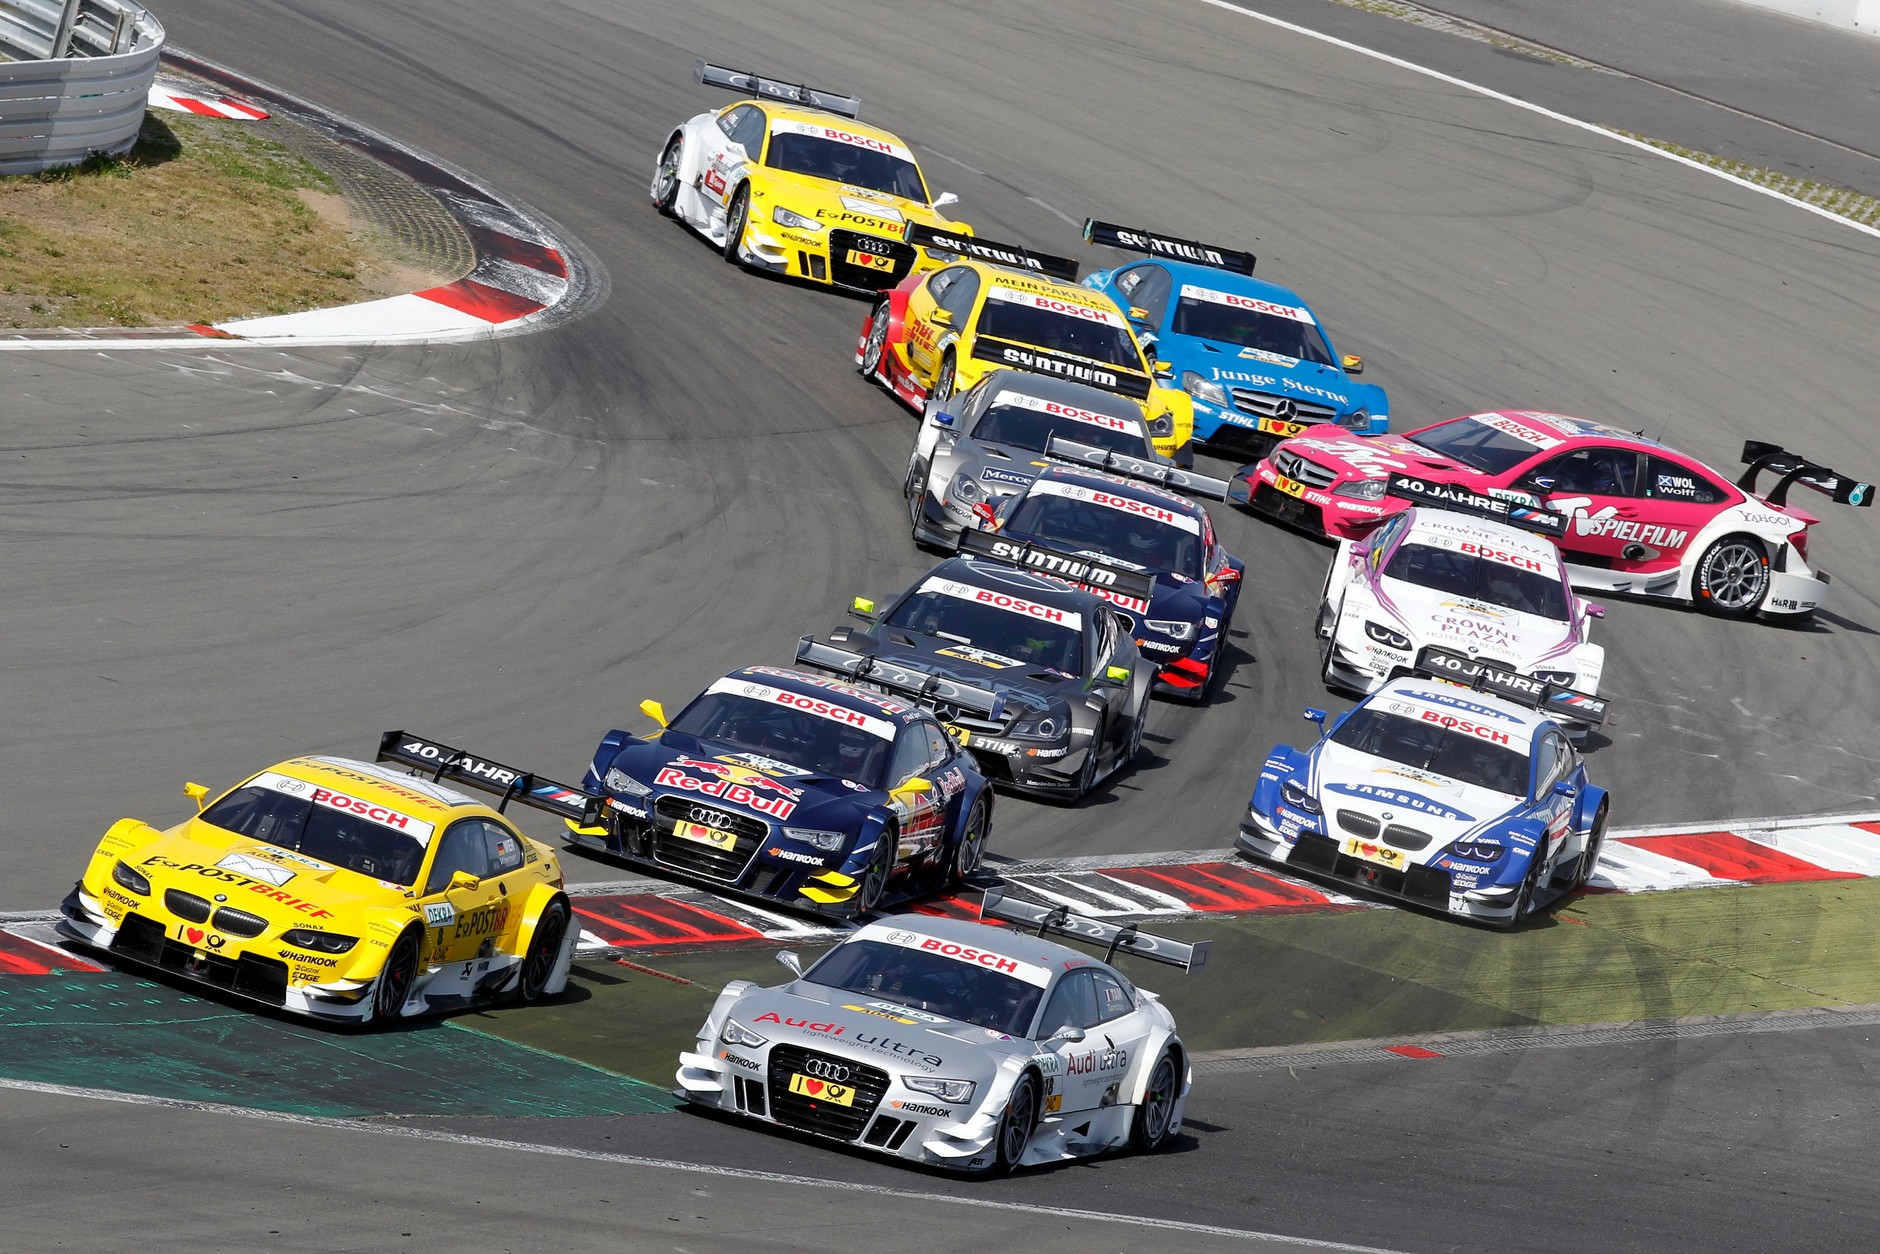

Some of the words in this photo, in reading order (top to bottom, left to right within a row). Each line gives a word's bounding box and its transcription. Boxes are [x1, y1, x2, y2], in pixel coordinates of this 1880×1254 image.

[824, 128, 891, 153] BOSCH
[996, 277, 1038, 289] MEIN
[1041, 286, 1089, 302] PAKET
[1036, 297, 1108, 321] BOSCH
[1226, 295, 1297, 318] BOSCH
[1211, 367, 1276, 387] Junge
[1282, 377, 1350, 406] Sterne
[1046, 403, 1124, 430] BOSCH
[1219, 411, 1255, 428] STIHL
[1494, 415, 1546, 443] BOSCH
[1660, 486, 1696, 497] Wolff
[1672, 477, 1695, 489] WOL
[1093, 492, 1173, 523] BOSCH
[1305, 491, 1331, 505] STIHL
[1396, 478, 1425, 494] 40
[1426, 486, 1509, 515] JAHRE
[1421, 522, 1495, 540] CROWNE
[1500, 538, 1552, 559] PLAZA
[1590, 517, 1688, 549] SPIELFILM
[1460, 543, 1542, 572] BOSCH
[976, 591, 1062, 622] BOSCH
[1772, 597, 1788, 608] H&R
[1431, 615, 1520, 643] CROWNE
[1441, 624, 1508, 647] PLAZA
[962, 647, 1014, 665] DEKRA
[1426, 632, 1466, 642] HOTELS
[1479, 642, 1522, 660] RESORTS
[1369, 662, 1390, 673] EDGE
[1430, 656, 1462, 671] 40
[1462, 665, 1544, 695] JAHRE
[776, 692, 866, 727] BOSCH
[1411, 689, 1511, 721] SAMSUNG
[1421, 710, 1510, 745] BOSCH
[403, 743, 439, 759] 40
[438, 755, 520, 786] JAHR
[732, 760, 771, 772] ADAC
[745, 754, 801, 773] DEKRA
[1400, 767, 1452, 785] DEKRA
[654, 767, 728, 798] Red
[723, 784, 797, 821] Bull
[1345, 783, 1458, 821] SAMSUNG
[310, 788, 409, 829] BOSCH
[1278, 826, 1298, 838] EDGE
[96, 849, 115, 857] EXIDE
[246, 851, 286, 865] ADAC
[264, 847, 321, 868] DEKRA
[134, 865, 154, 879] SONAX
[1453, 880, 1478, 888] EDGE
[104, 908, 123, 920] EDGE
[293, 922, 325, 931] SONAX
[436, 927, 445, 945] 8
[370, 939, 389, 949] EXIDE
[920, 938, 1018, 973] BOSCH
[292, 971, 320, 982] EDGE
[300, 966, 320, 974] Castrol
[861, 1008, 901, 1022] ADAC
[879, 1003, 936, 1022] DEKRA
[752, 1012, 847, 1035] Audi
[856, 1033, 943, 1068] ultra
[803, 1029, 868, 1050] lightweight
[871, 1047, 937, 1074] technology
[1066, 1049, 1096, 1076] Audi
[967, 1157, 986, 1167] ABT
